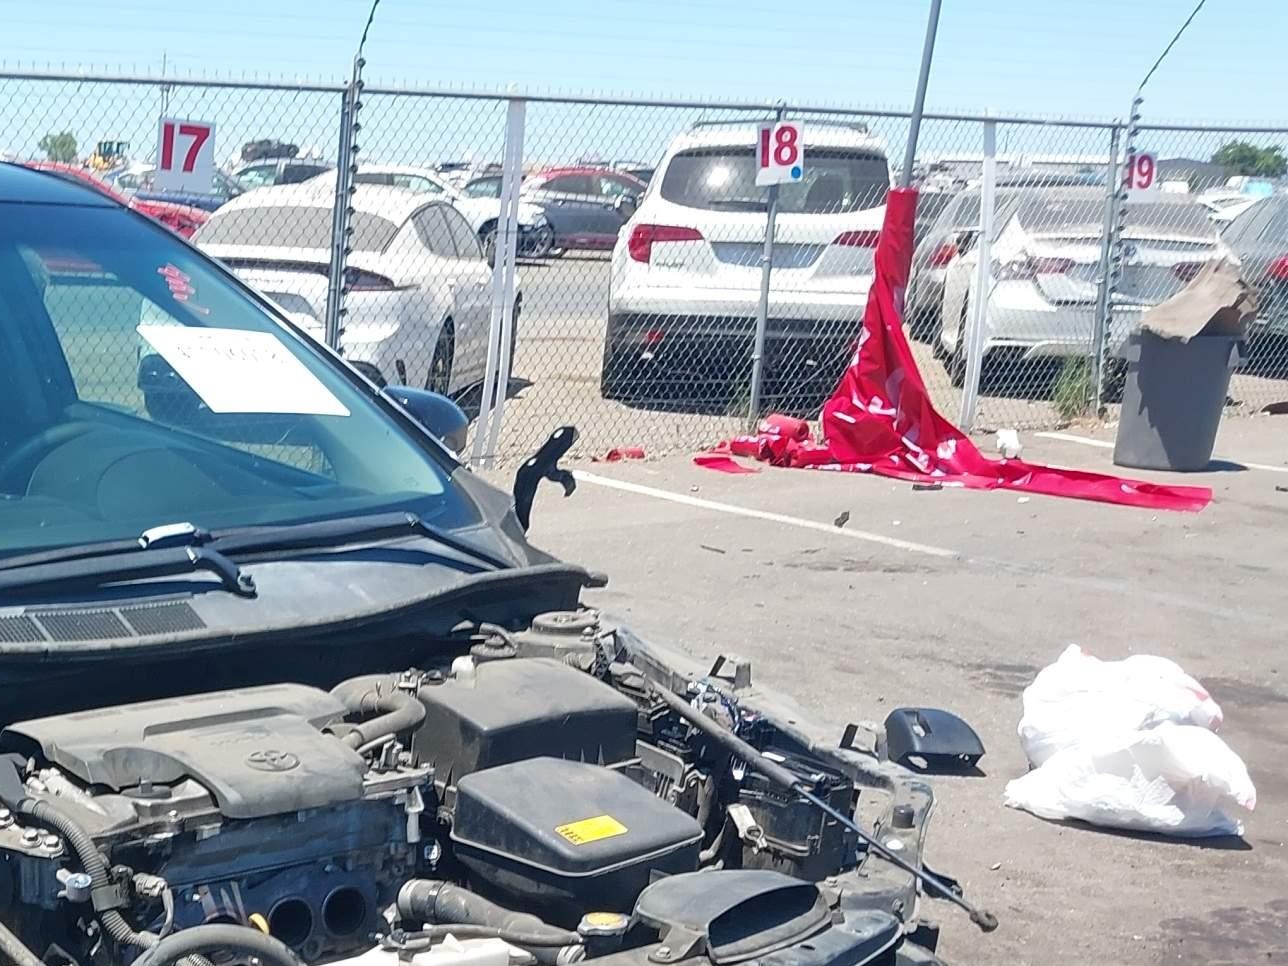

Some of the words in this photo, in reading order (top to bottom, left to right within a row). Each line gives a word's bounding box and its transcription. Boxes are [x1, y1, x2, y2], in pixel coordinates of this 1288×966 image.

[161, 122, 210, 172] 17
[761, 126, 798, 168] 18
[1127, 154, 1154, 189] 19
